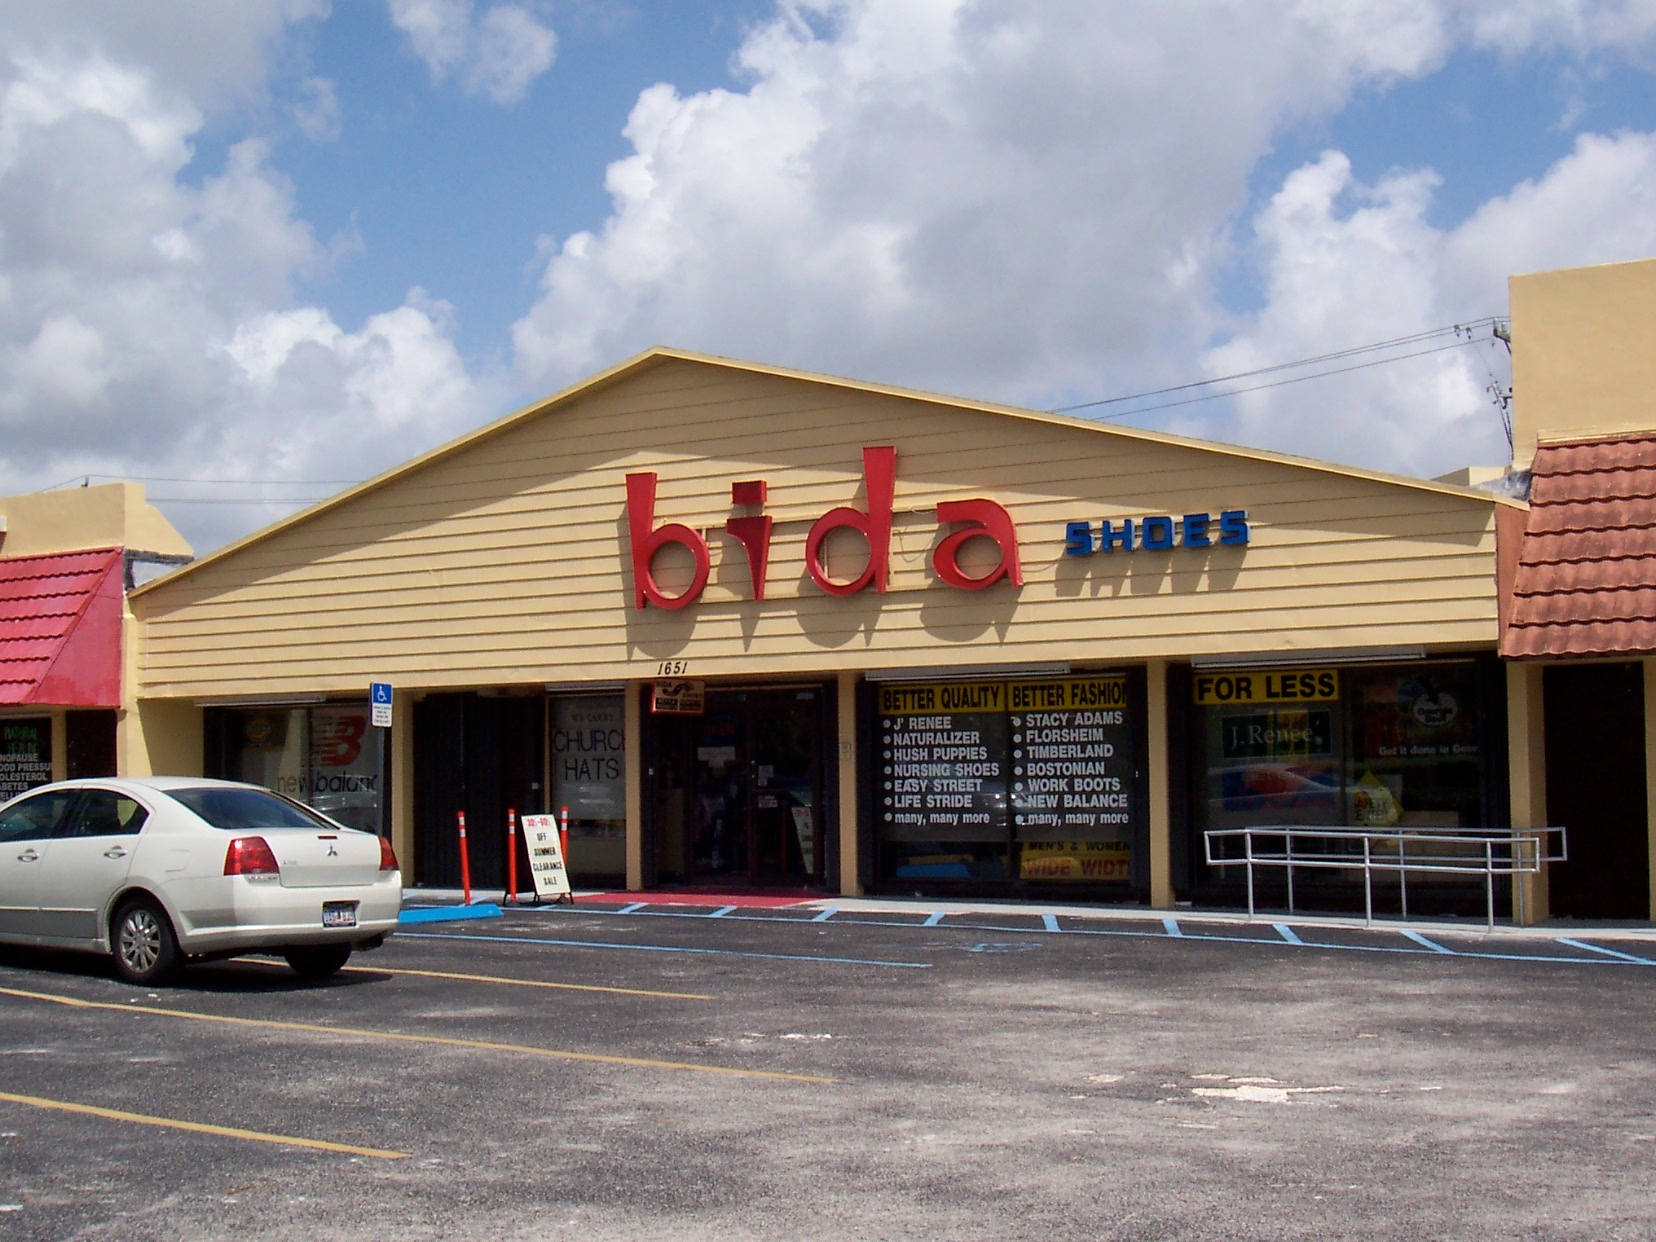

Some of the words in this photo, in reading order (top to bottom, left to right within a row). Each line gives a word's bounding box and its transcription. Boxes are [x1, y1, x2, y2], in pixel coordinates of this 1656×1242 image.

[626, 445, 1023, 610] bida
[1066, 510, 1250, 557] SHOES
[657, 661, 688, 676] 1651
[1197, 677, 1252, 700] FOR
[1266, 673, 1335, 698] LESS
[883, 688, 935, 711] BETTER
[941, 685, 1000, 709] QUALITY
[1012, 684, 1065, 707] BETTER
[909, 716, 952, 730] RENEE
[1026, 714, 1069, 727] STACY
[1075, 711, 1123, 725] ADAMS
[893, 731, 980, 746] NATURALIZER
[1026, 728, 1104, 743] FLORSHEIM
[893, 748, 928, 761] HUSH
[933, 747, 988, 760] PUPPIES
[1027, 744, 1114, 759] TIMBERLAND
[1378, 746, 1397, 756] Get
[1410, 745, 1437, 755] done
[564, 758, 619, 780] HATS
[893, 764, 951, 777] NURSING
[955, 763, 1000, 776] SHOES
[1027, 761, 1105, 776] BOSTONIAN
[894, 780, 928, 792] EASY
[933, 779, 983, 792] STREET
[1028, 778, 1069, 792] WORK
[1074, 777, 1121, 791] BOOTS
[894, 796, 922, 808] LIFE
[926, 795, 973, 808] STRIDE
[1028, 794, 1060, 808] NEW
[1064, 793, 1128, 808] BALANCE
[894, 813, 927, 825] many,
[930, 812, 959, 825] many
[963, 812, 990, 823] more
[1028, 814, 1061, 826] many,
[1065, 813, 1096, 826] many
[1100, 812, 1129, 824] more
[536, 832, 547, 842] OFF
[534, 847, 556, 857] SUMMER
[532, 861, 562, 872] CLEARANCE
[1027, 859, 1071, 877] WIDE
[543, 876, 558, 886] SALE
